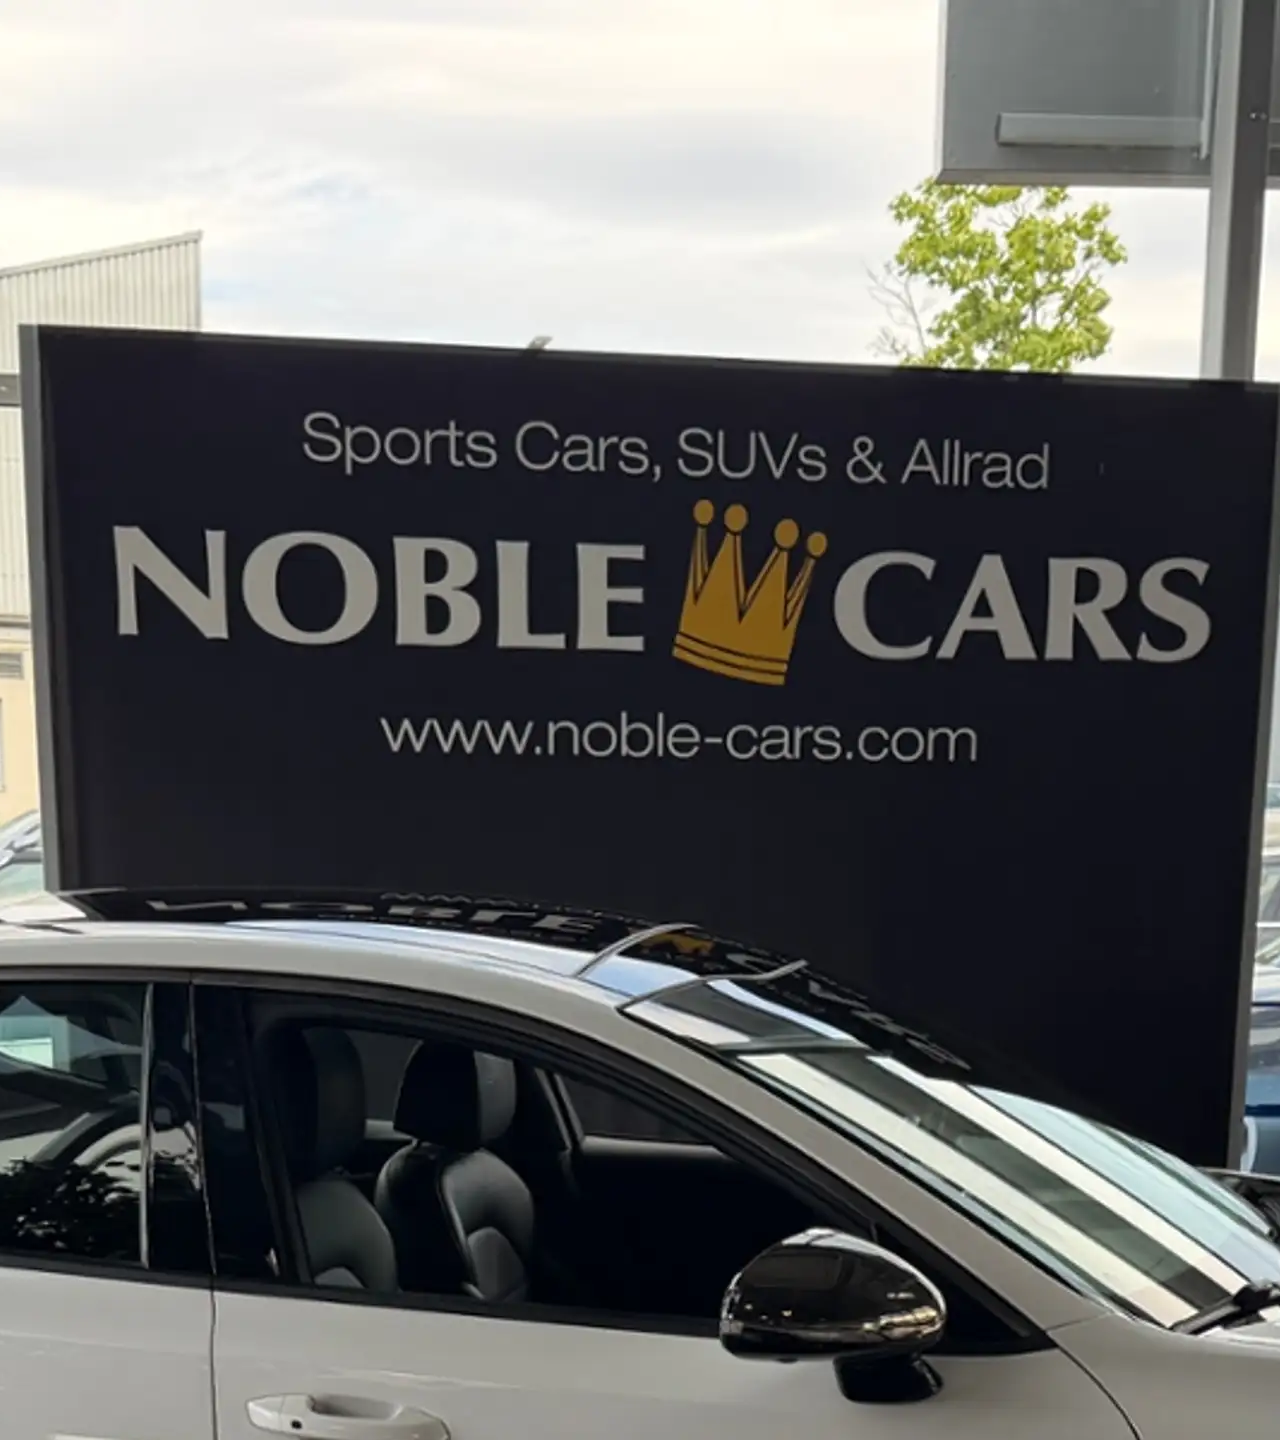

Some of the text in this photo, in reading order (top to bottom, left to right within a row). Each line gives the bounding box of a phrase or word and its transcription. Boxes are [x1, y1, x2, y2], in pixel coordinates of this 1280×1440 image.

[302, 410, 1050, 489] Sports Cars, SUVs & Allrad
[112, 524, 1211, 663] NOBLE CARS
[380, 710, 978, 762] www.noble-cars.com
